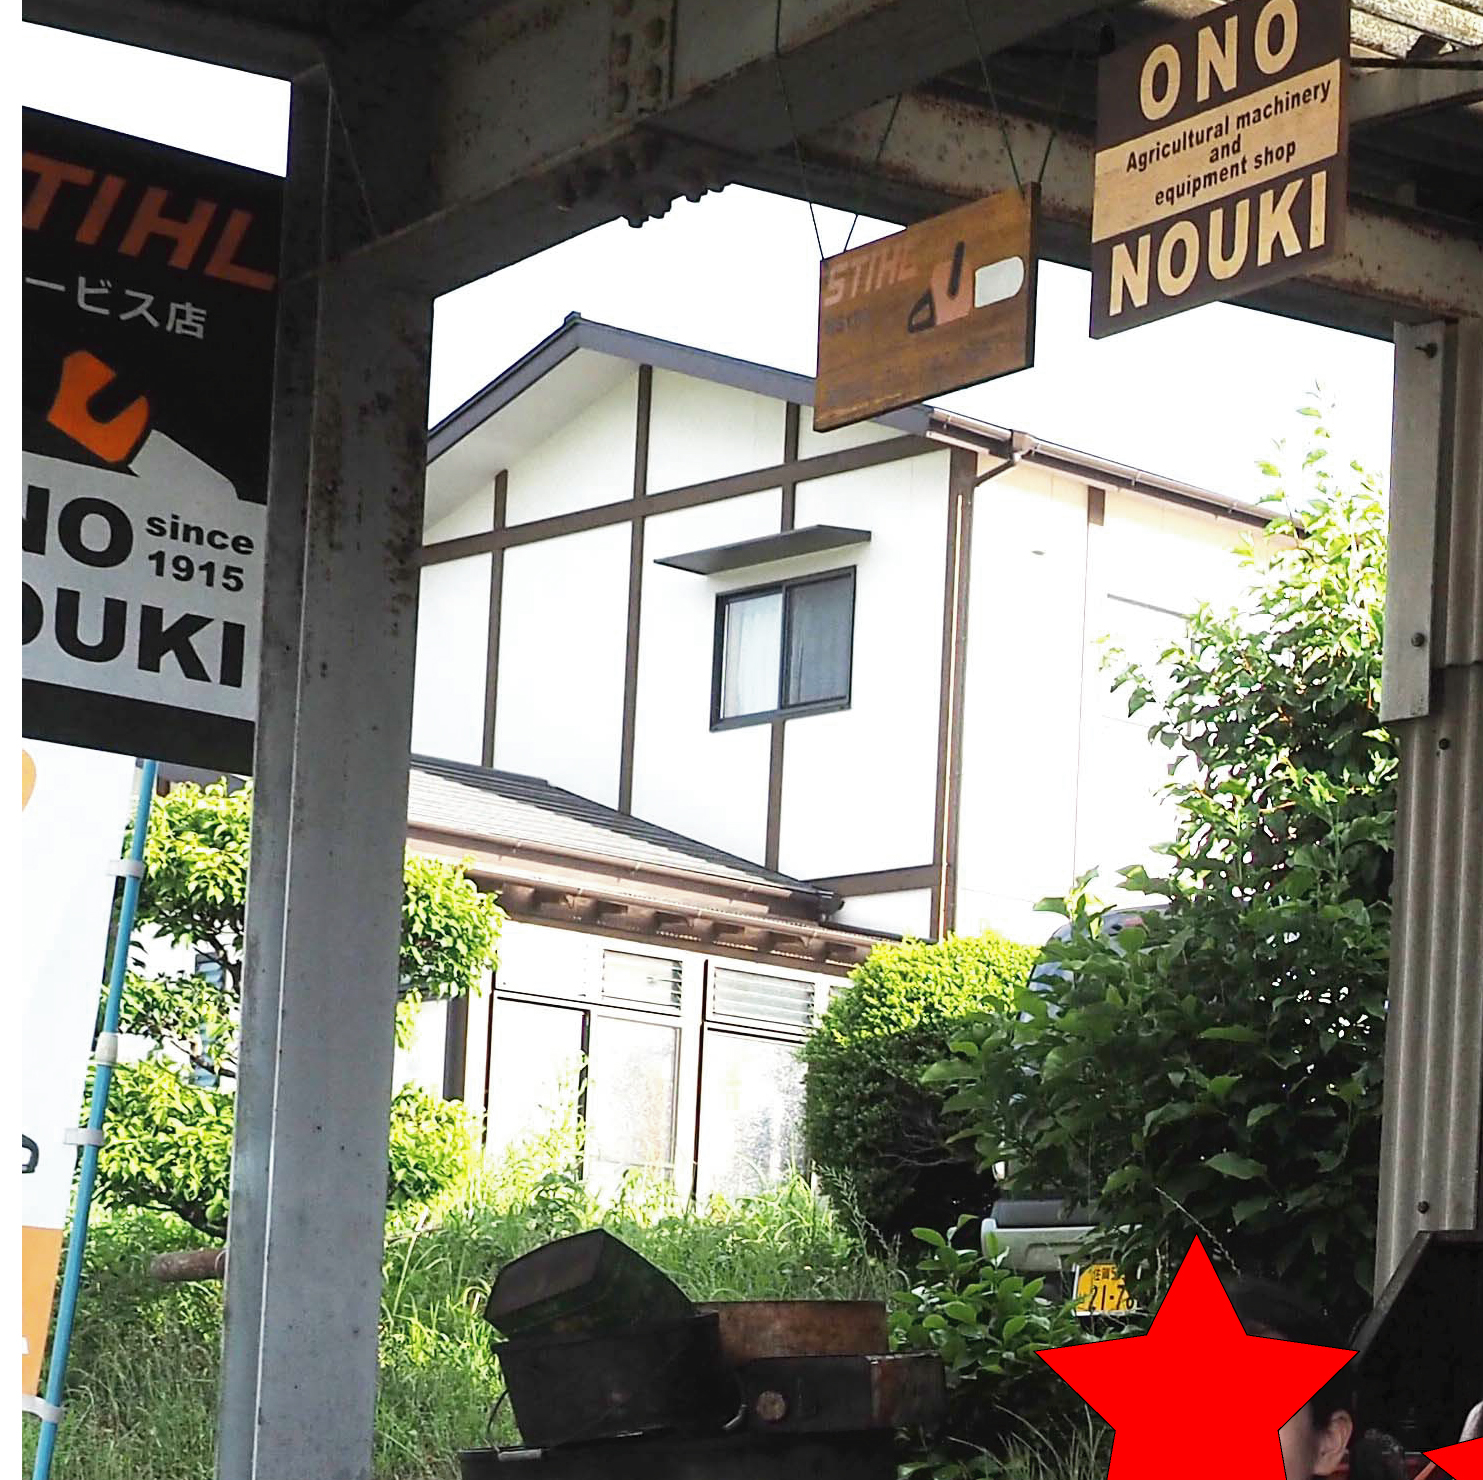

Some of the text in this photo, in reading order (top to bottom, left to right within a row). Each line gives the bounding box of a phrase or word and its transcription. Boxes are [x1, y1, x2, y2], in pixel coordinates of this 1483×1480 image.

[1140, 0, 1298, 120] ONO
[1126, 80, 1331, 172] Agricultural machinery
[1209, 133, 1242, 164] and
[1154, 141, 1297, 206] equipment shop
[823, 246, 919, 307] STIHL
[1109, 171, 1327, 317] NOUKI
[145, 514, 255, 555] since
[147, 550, 245, 592] 1915
[22, 581, 246, 688] UKI
